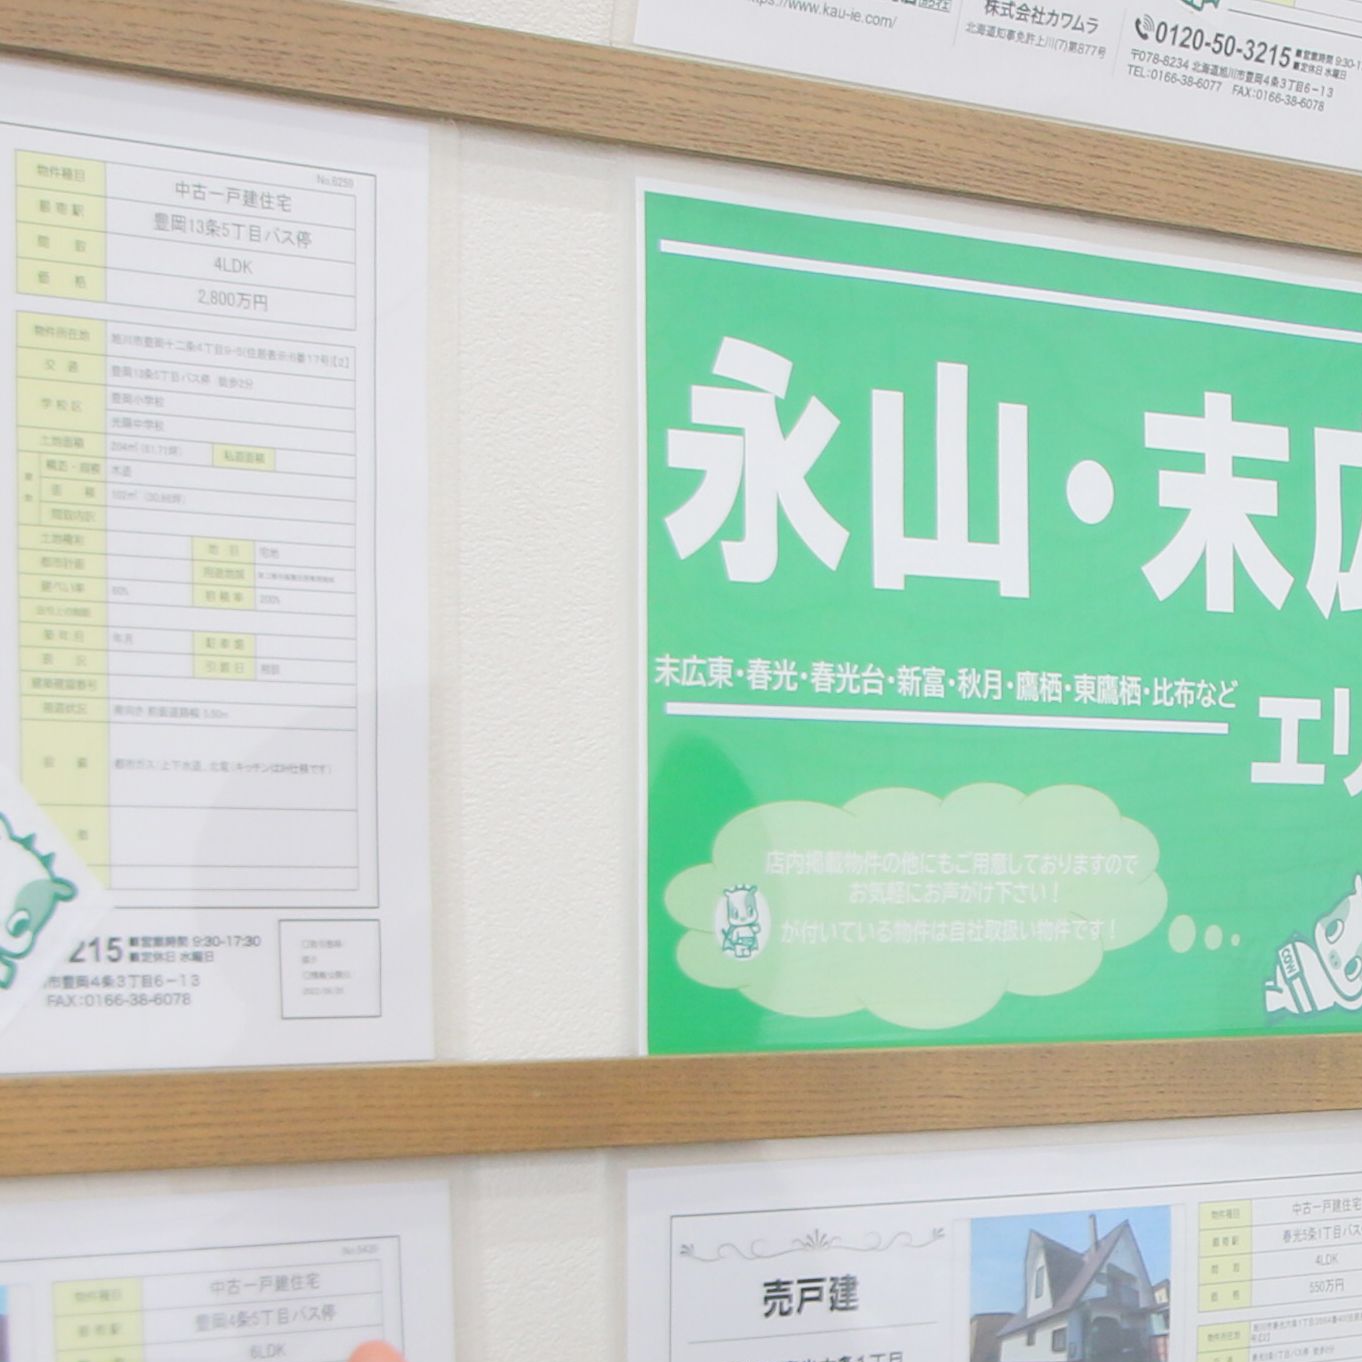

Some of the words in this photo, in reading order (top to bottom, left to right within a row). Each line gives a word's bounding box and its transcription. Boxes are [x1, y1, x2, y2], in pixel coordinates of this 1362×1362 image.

[984, 0, 1099, 35] 株式会社カワムラ
[1155, 20, 1292, 69] 0120-50-3215
[1127, 65, 1223, 93] TEL:0166-38-6077
[1232, 84, 1325, 112] FAX:0166-38-6078
[175, 180, 293, 213] 中古一戸建住宅
[153, 212, 313, 249] 豊岡13条5丁目バス停
[214, 256, 254, 274] 4LDK
[198, 289, 269, 313] 2,800万円
[653, 653, 1239, 711] 末広東・春光・春光台・新富・秋月・鷹栖・東鷹栖・比布など
[1292, 1196, 1362, 1216] 中古一戸建住宅
[209, 1272, 321, 1296] 中古一戸建住宅
[761, 1274, 860, 1318] 売戸建
[1309, 1278, 1345, 1294] 550万円
